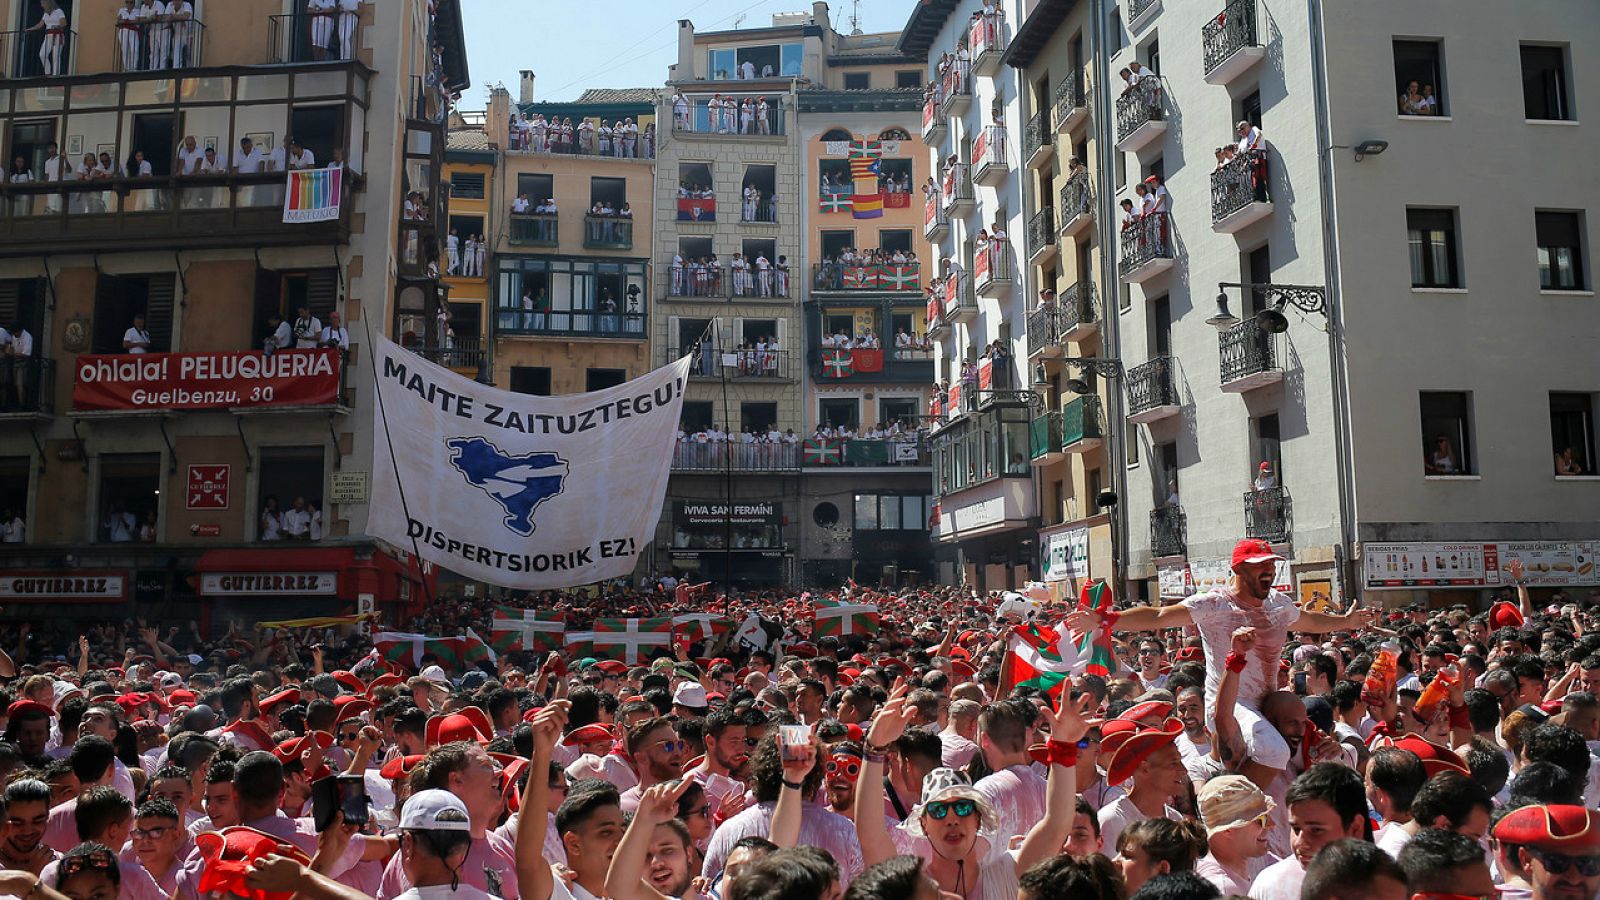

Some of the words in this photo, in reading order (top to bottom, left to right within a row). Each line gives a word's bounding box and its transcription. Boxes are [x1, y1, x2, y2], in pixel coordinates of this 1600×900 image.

[79, 358, 168, 383] ohlala!
[180, 352, 333, 381] PELUQUERIA
[131, 388, 241, 405] Guelbenzu,
[250, 386, 274, 402] 30
[383, 356, 473, 419] MAITE
[483, 377, 682, 434] ZAITUZTEGU!
[711, 505, 732, 515] SAN
[407, 518, 593, 573] DISPERTSIORIK
[600, 537, 636, 559] EZ!
[12, 578, 107, 594] GUTIERREZ
[219, 575, 319, 591] GUTIERREZ
